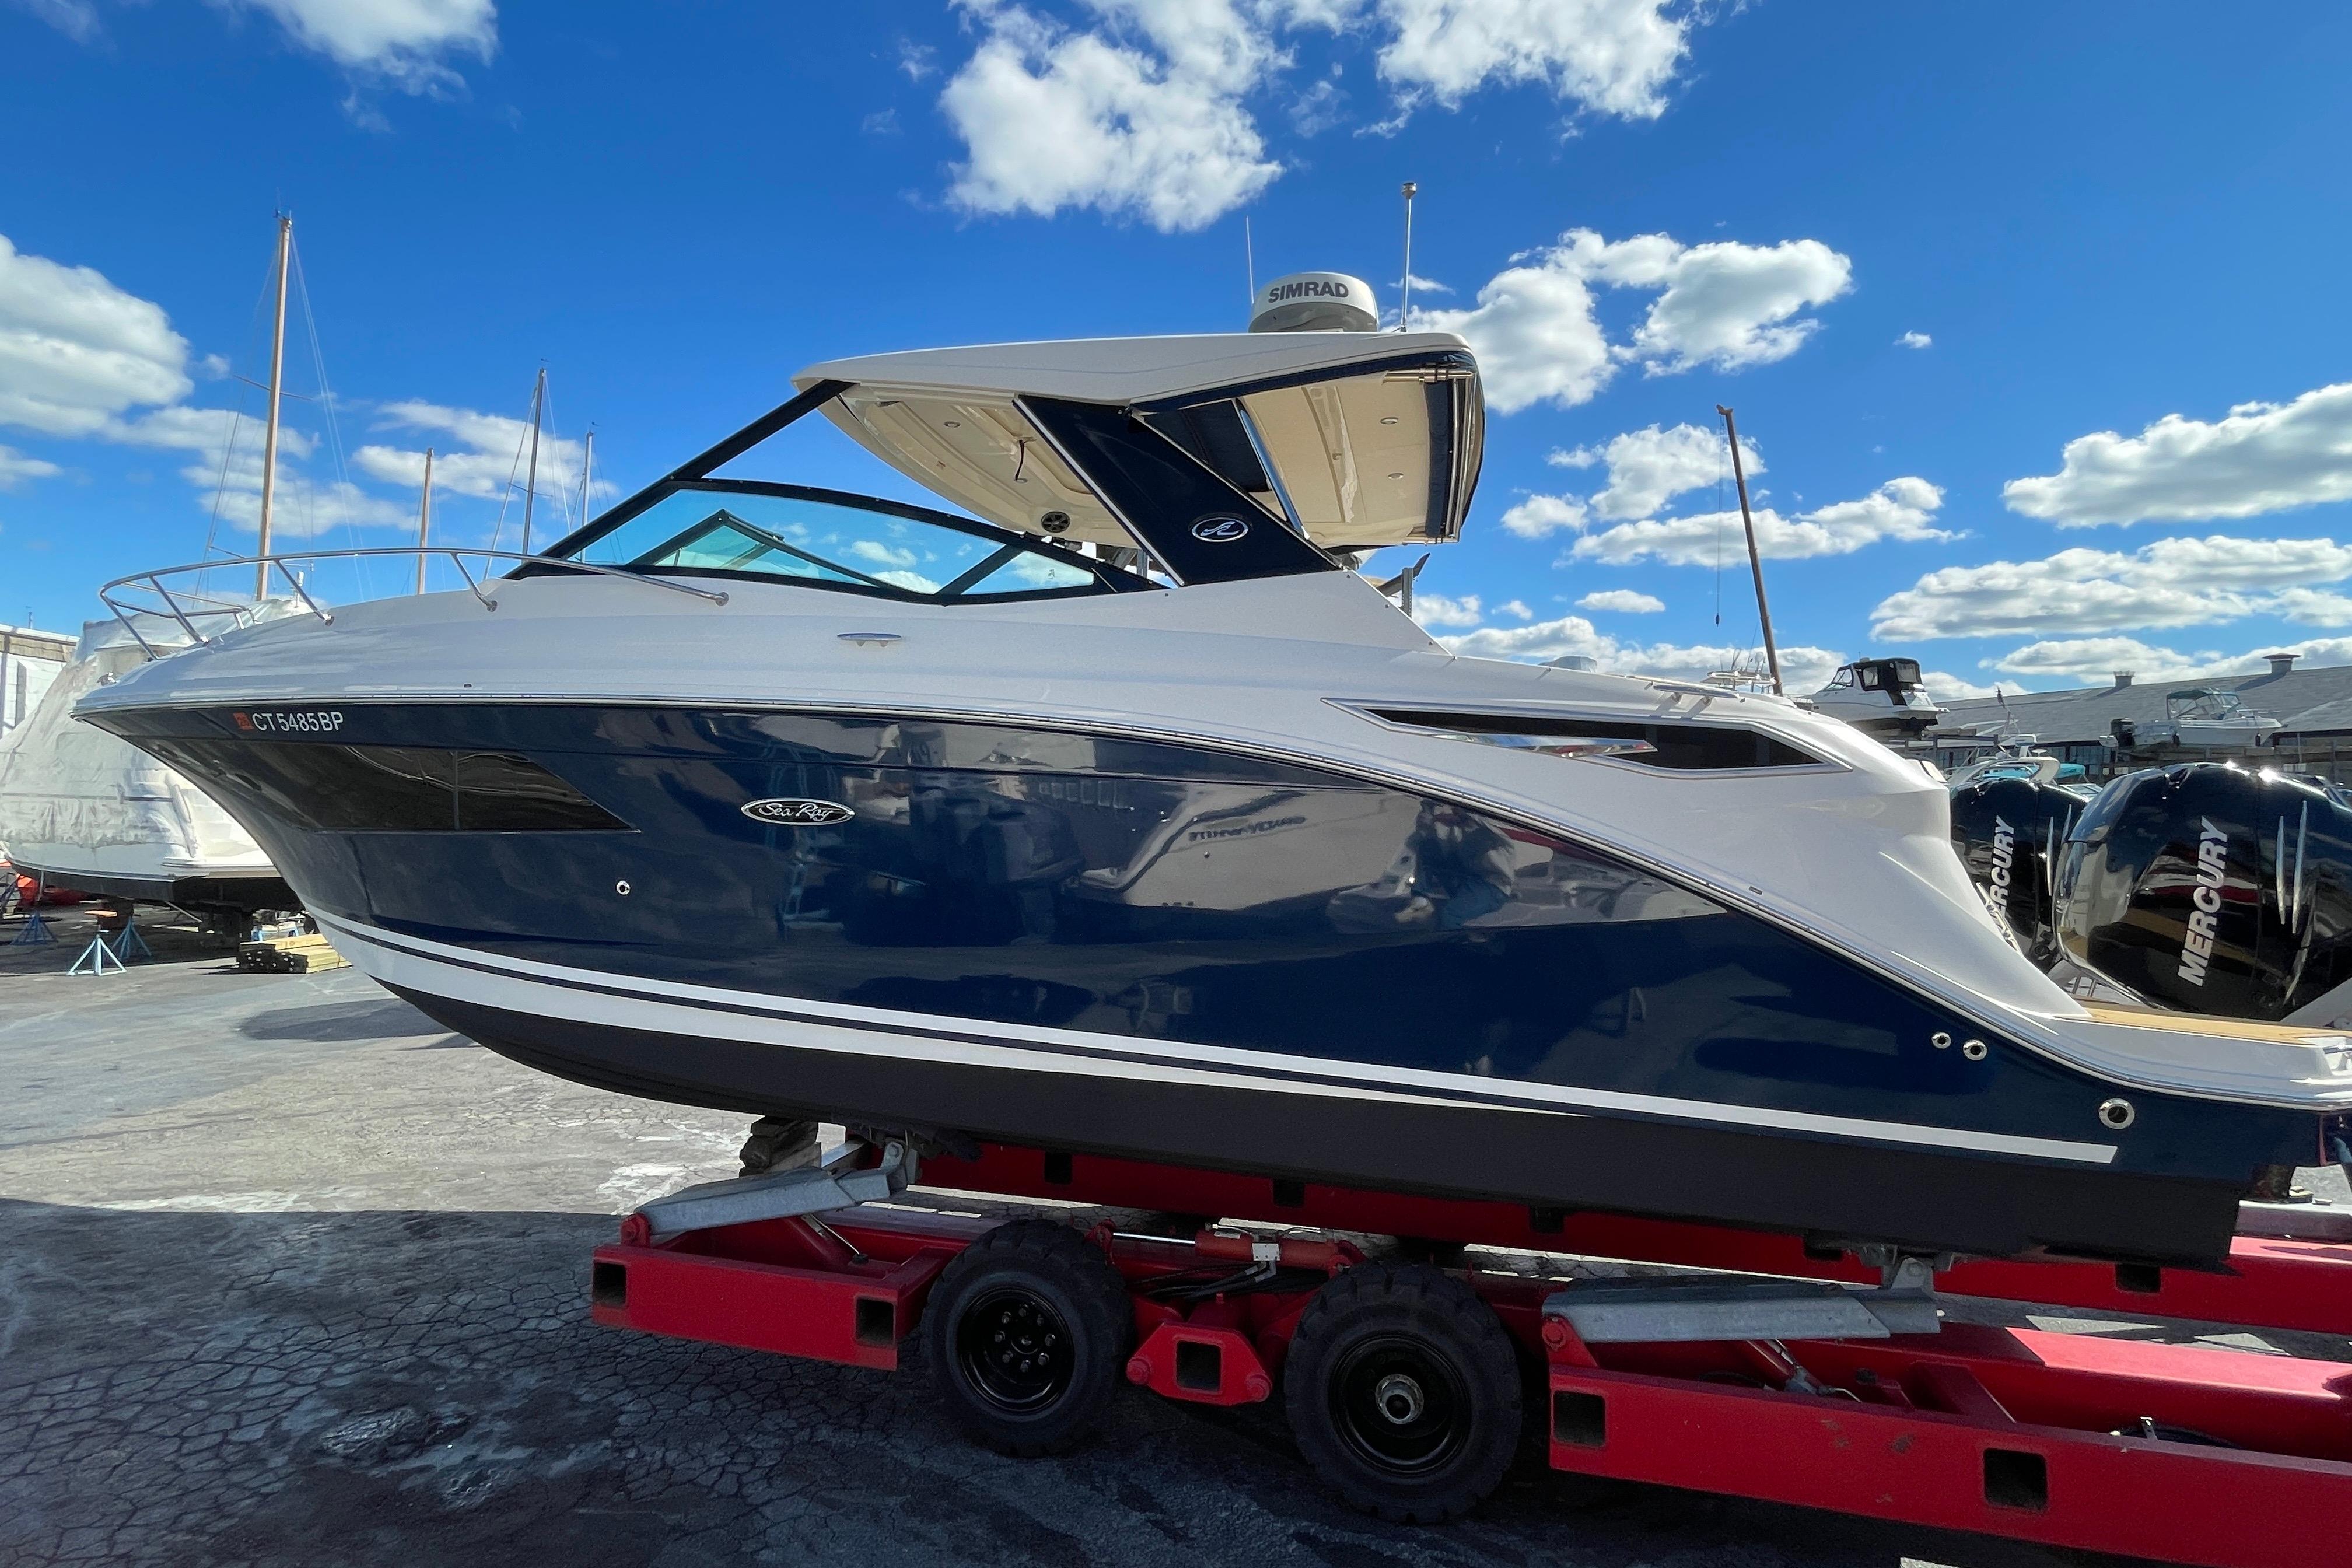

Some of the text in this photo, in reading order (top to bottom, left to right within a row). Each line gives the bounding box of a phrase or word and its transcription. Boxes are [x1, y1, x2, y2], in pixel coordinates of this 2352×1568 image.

[1268, 281, 1349, 303] SIMRAD
[252, 712, 344, 732] CT 5485BP
[758, 803, 834, 822] Sea Ray
[2178, 816, 2227, 986] MERCURY
